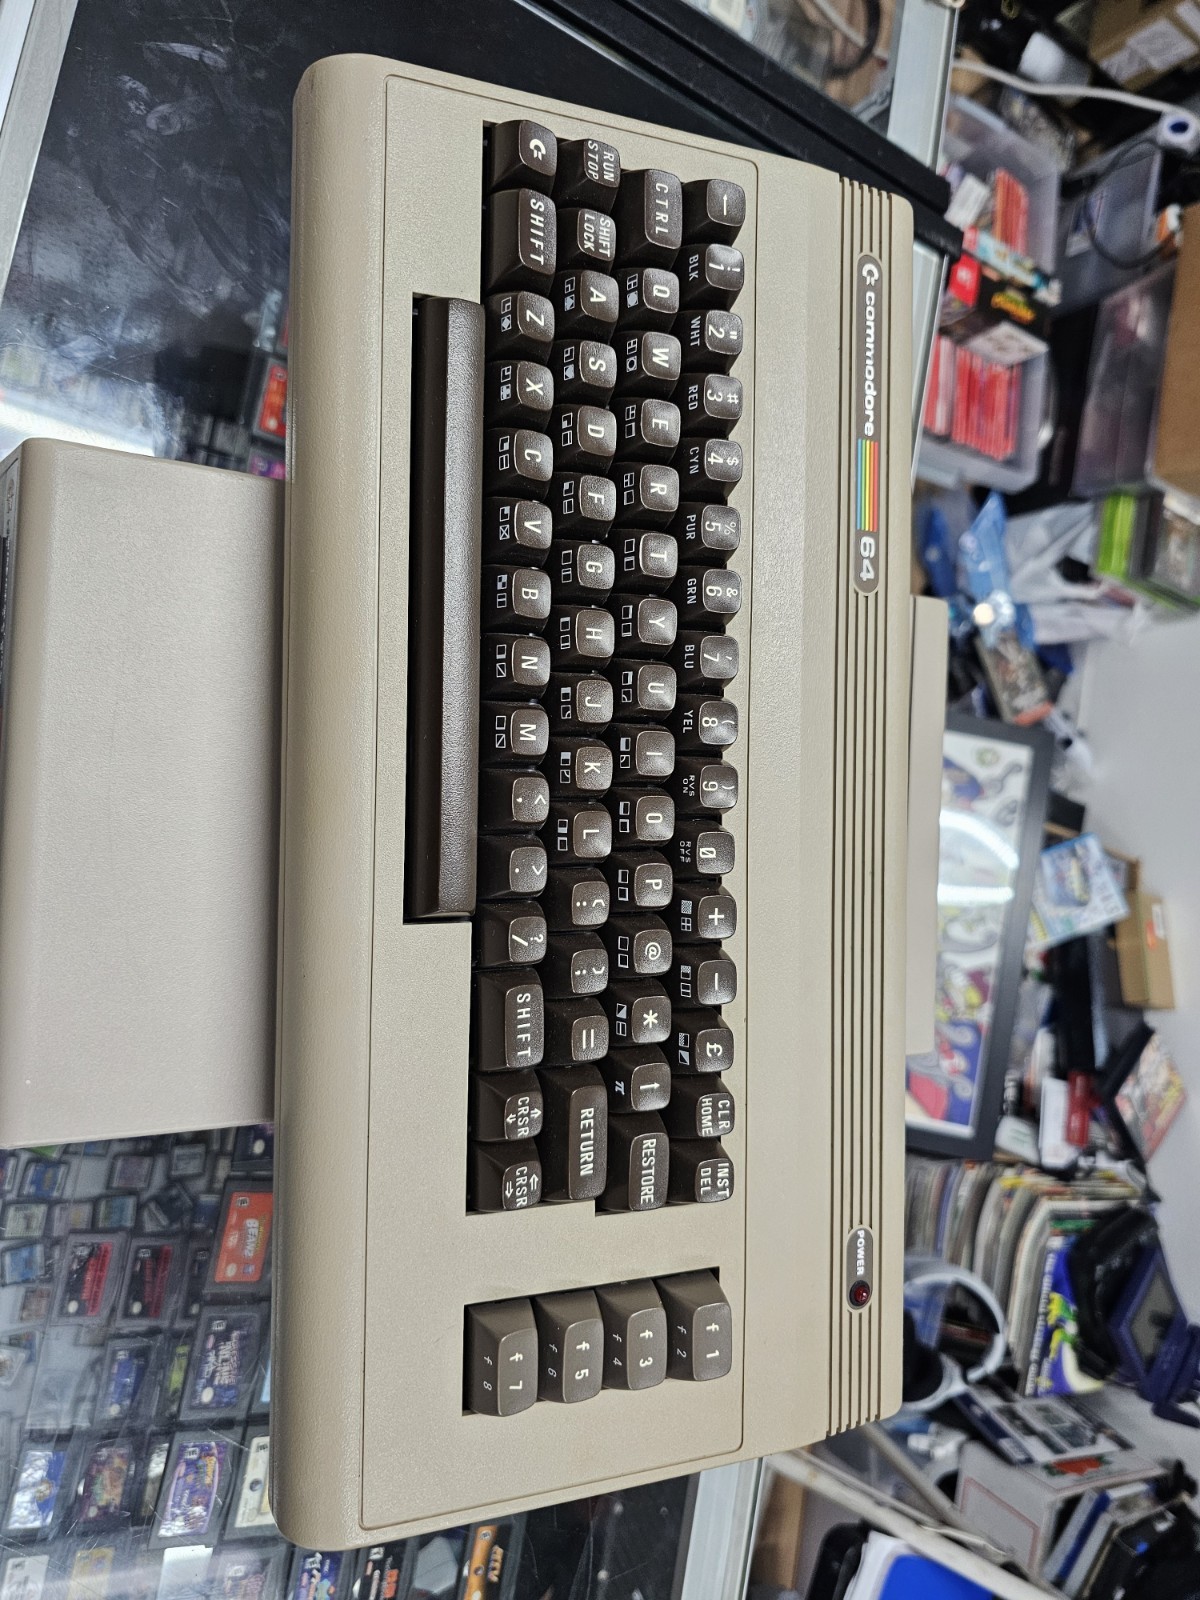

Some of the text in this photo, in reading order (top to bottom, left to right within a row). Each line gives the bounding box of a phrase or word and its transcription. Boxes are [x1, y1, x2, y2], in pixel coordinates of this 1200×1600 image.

[587, 140, 599, 180] STOP
[602, 151, 614, 182] RUN
[655, 182, 669, 235] CTRL
[529, 198, 544, 265] SHIFT
[583, 213, 596, 251] LOCK
[599, 217, 611, 257] SHIFT
[688, 254, 698, 281] BLK
[709, 263, 724, 271] 1
[589, 286, 607, 303] A
[652, 284, 670, 298] Q
[526, 309, 544, 327] Z
[689, 316, 700, 347] WHT
[709, 325, 724, 337] 2
[588, 357, 606, 372] S
[652, 348, 669, 369] W
[526, 378, 544, 396] X
[687, 385, 698, 411] RED
[707, 389, 723, 401] 3
[727, 393, 739, 404] #
[587, 424, 605, 439] D
[652, 418, 669, 431] E
[859, 290, 877, 581] commodore 64
[524, 449, 543, 463] C
[688, 447, 699, 474] CYN
[708, 453, 723, 465] 4
[726, 457, 739, 466] $
[650, 482, 667, 496] R
[587, 491, 604, 505] F
[524, 520, 541, 534] V
[685, 514, 697, 540] PUR
[705, 522, 720, 532] 5
[724, 521, 736, 536] %
[650, 551, 667, 563] T
[585, 561, 602, 573] G
[521, 588, 539, 600] B
[686, 578, 698, 605] GRN
[706, 585, 722, 597] 6
[726, 588, 738, 598] &
[648, 616, 665, 629] Y
[585, 627, 602, 641] H
[521, 655, 538, 669] N
[684, 644, 695, 669] BLU
[703, 653, 718, 662] 7
[648, 682, 664, 694] U
[584, 696, 601, 708] J
[682, 710, 694, 734] YEL
[702, 717, 718, 727] 8
[519, 723, 536, 741] M
[584, 762, 600, 774] K
[682, 778, 689, 794] ON
[702, 781, 718, 791] 9
[646, 812, 663, 824] O
[583, 829, 599, 840] L
[646, 879, 663, 890] P
[511, 934, 527, 946] /
[531, 934, 543, 943] ?
[645, 941, 662, 961] @
[516, 993, 531, 1057] SHIFT
[582, 1029, 595, 1050] =
[706, 1042, 722, 1057] £
[517, 1097, 530, 1137] CRSR
[701, 1097, 713, 1136] HOME
[718, 1100, 730, 1129] CLR
[579, 1109, 595, 1176] RETURN
[640, 1139, 656, 1204] RESTORE
[515, 1166, 528, 1207] CRSR
[700, 1168, 712, 1195] DEL
[717, 1163, 730, 1197] INST
[856, 1229, 865, 1276] POWER
